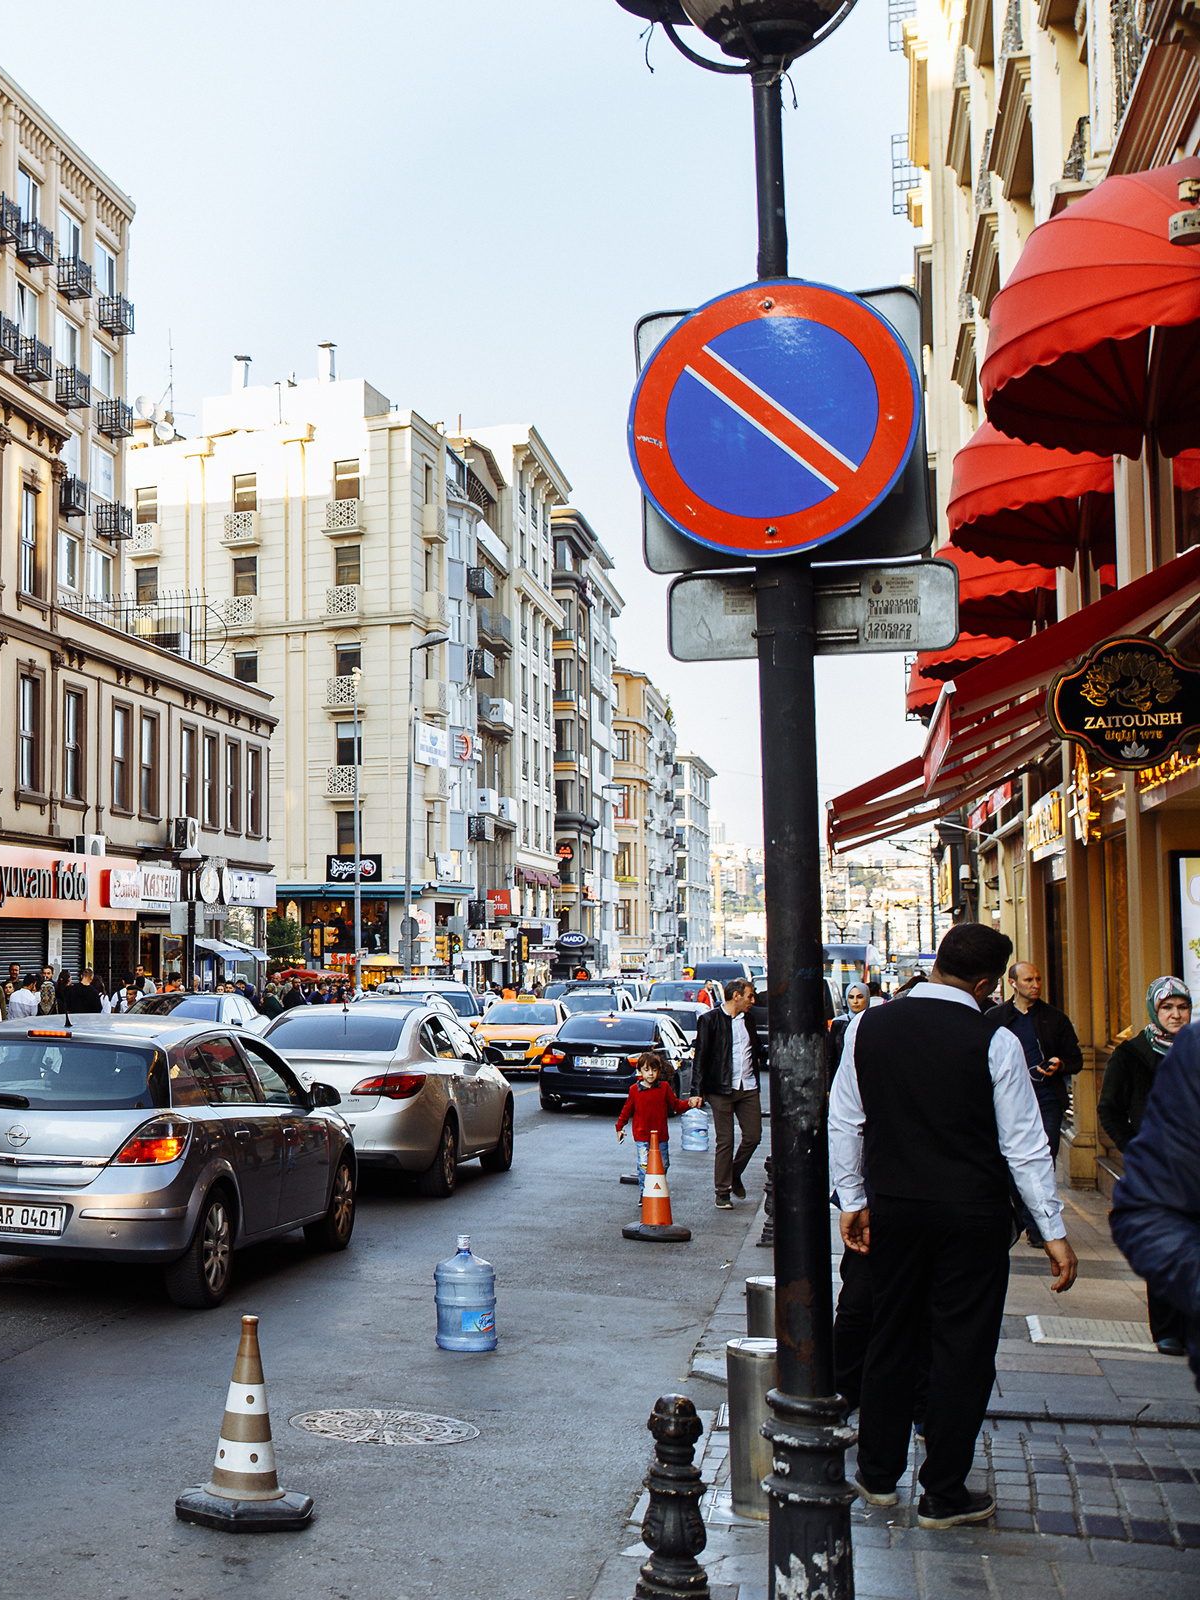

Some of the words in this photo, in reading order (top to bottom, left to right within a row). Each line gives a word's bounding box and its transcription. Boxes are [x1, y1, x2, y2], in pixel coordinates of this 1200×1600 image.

[869, 598, 919, 608] ST13035406
[868, 622, 912, 631] 1205922
[1084, 712, 1182, 729] ZAITOUNEH
[55, 860, 87, 901] foto
[113, 880, 140, 898] Canon
[563, 935, 583, 943] MADO
[600, 1059, 616, 1067] 0123
[20, 1208, 56, 1228] 0401
